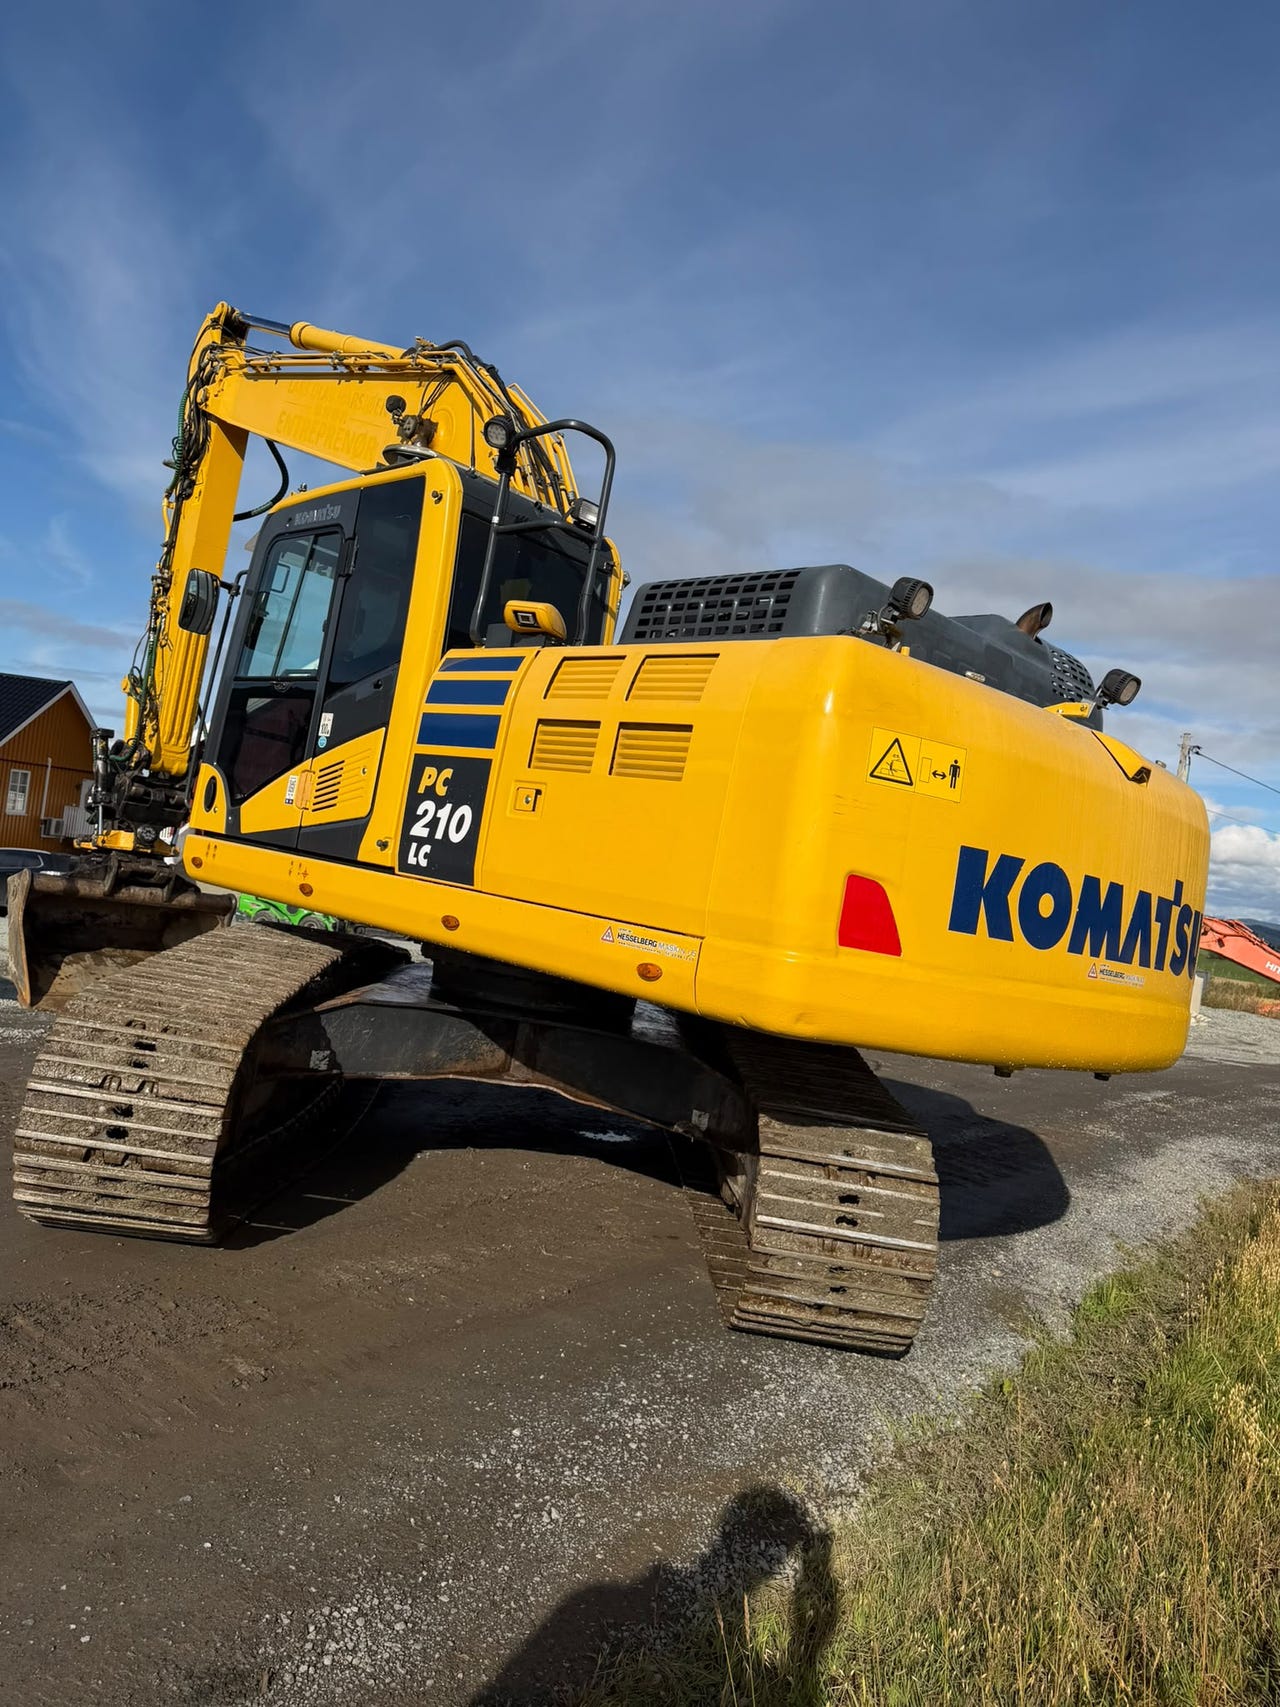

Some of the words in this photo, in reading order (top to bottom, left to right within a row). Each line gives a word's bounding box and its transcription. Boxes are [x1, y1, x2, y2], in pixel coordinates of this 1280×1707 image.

[417, 766, 454, 797] PC
[409, 800, 473, 844] 210
[407, 842, 432, 867] LC
[948, 845, 1203, 979] KOMATSU
[617, 932, 658, 948] HESSELBERG
